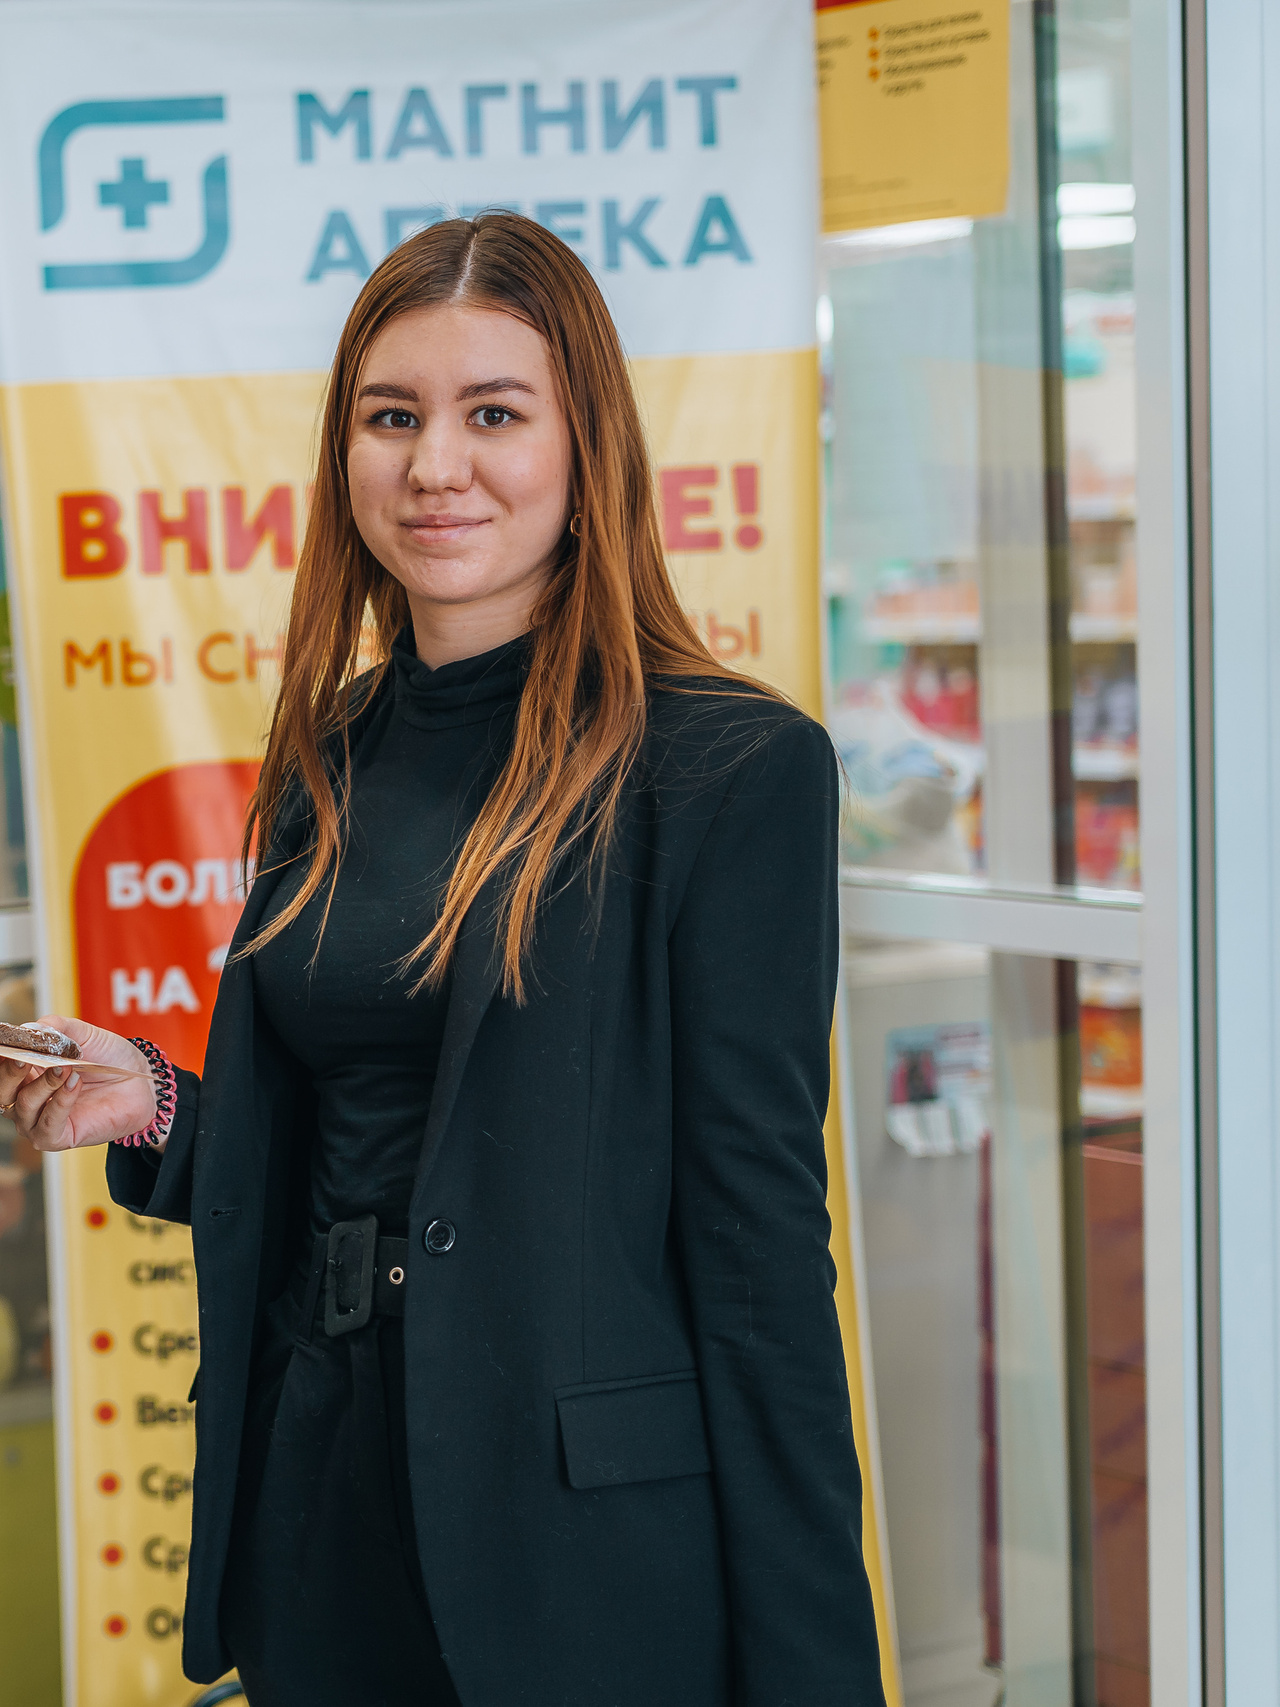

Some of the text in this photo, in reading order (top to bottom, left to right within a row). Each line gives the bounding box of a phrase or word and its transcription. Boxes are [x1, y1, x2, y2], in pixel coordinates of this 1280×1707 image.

[295, 76, 738, 164] МАГНИТ
[63, 636, 174, 688] МЫ
[111, 966, 200, 1016] НА
